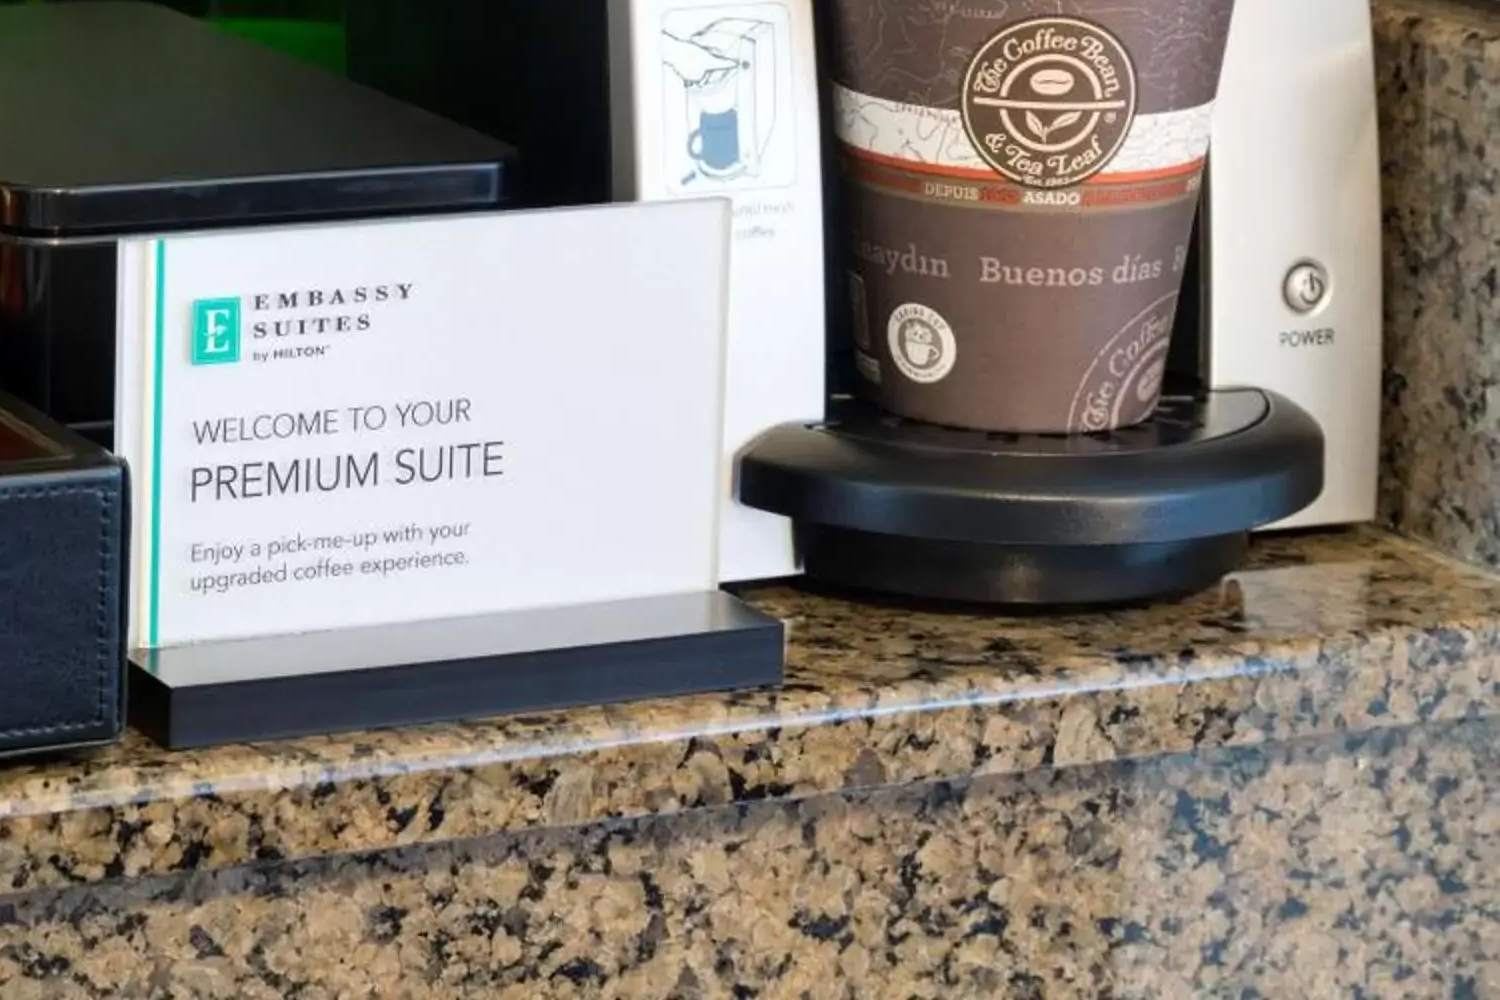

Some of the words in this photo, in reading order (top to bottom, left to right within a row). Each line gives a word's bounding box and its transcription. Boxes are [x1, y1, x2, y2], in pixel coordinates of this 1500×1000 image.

[973, 57, 1007, 93] The
[1003, 28, 1077, 61] Coffee
[1080, 36, 1120, 98] Bean
[985, 133, 1006, 153] &
[1006, 145, 1044, 175] Tea
[1048, 134, 1103, 176] Leaf
[925, 182, 980, 201] DEPUIS
[1022, 191, 1081, 206] ASADO
[979, 256, 1104, 287] Buenos
[1112, 253, 1162, 284] días
[254, 283, 413, 310] EMBASSY
[252, 314, 371, 339] SUITES
[1279, 328, 1335, 348] POWER
[253, 350, 269, 363] by
[192, 409, 339, 445] WELCOME
[348, 404, 387, 432] TO
[395, 398, 472, 428] YOUR
[190, 451, 379, 503] PREMIUM
[394, 441, 505, 486] SUITE
[190, 542, 244, 565] Enjoy
[250, 541, 261, 557] a
[267, 526, 378, 559] pick-me-up
[383, 523, 423, 545] with
[429, 521, 472, 542] your
[190, 562, 288, 595] upgraded
[293, 556, 354, 583] coffee
[361, 549, 471, 578] experience.
